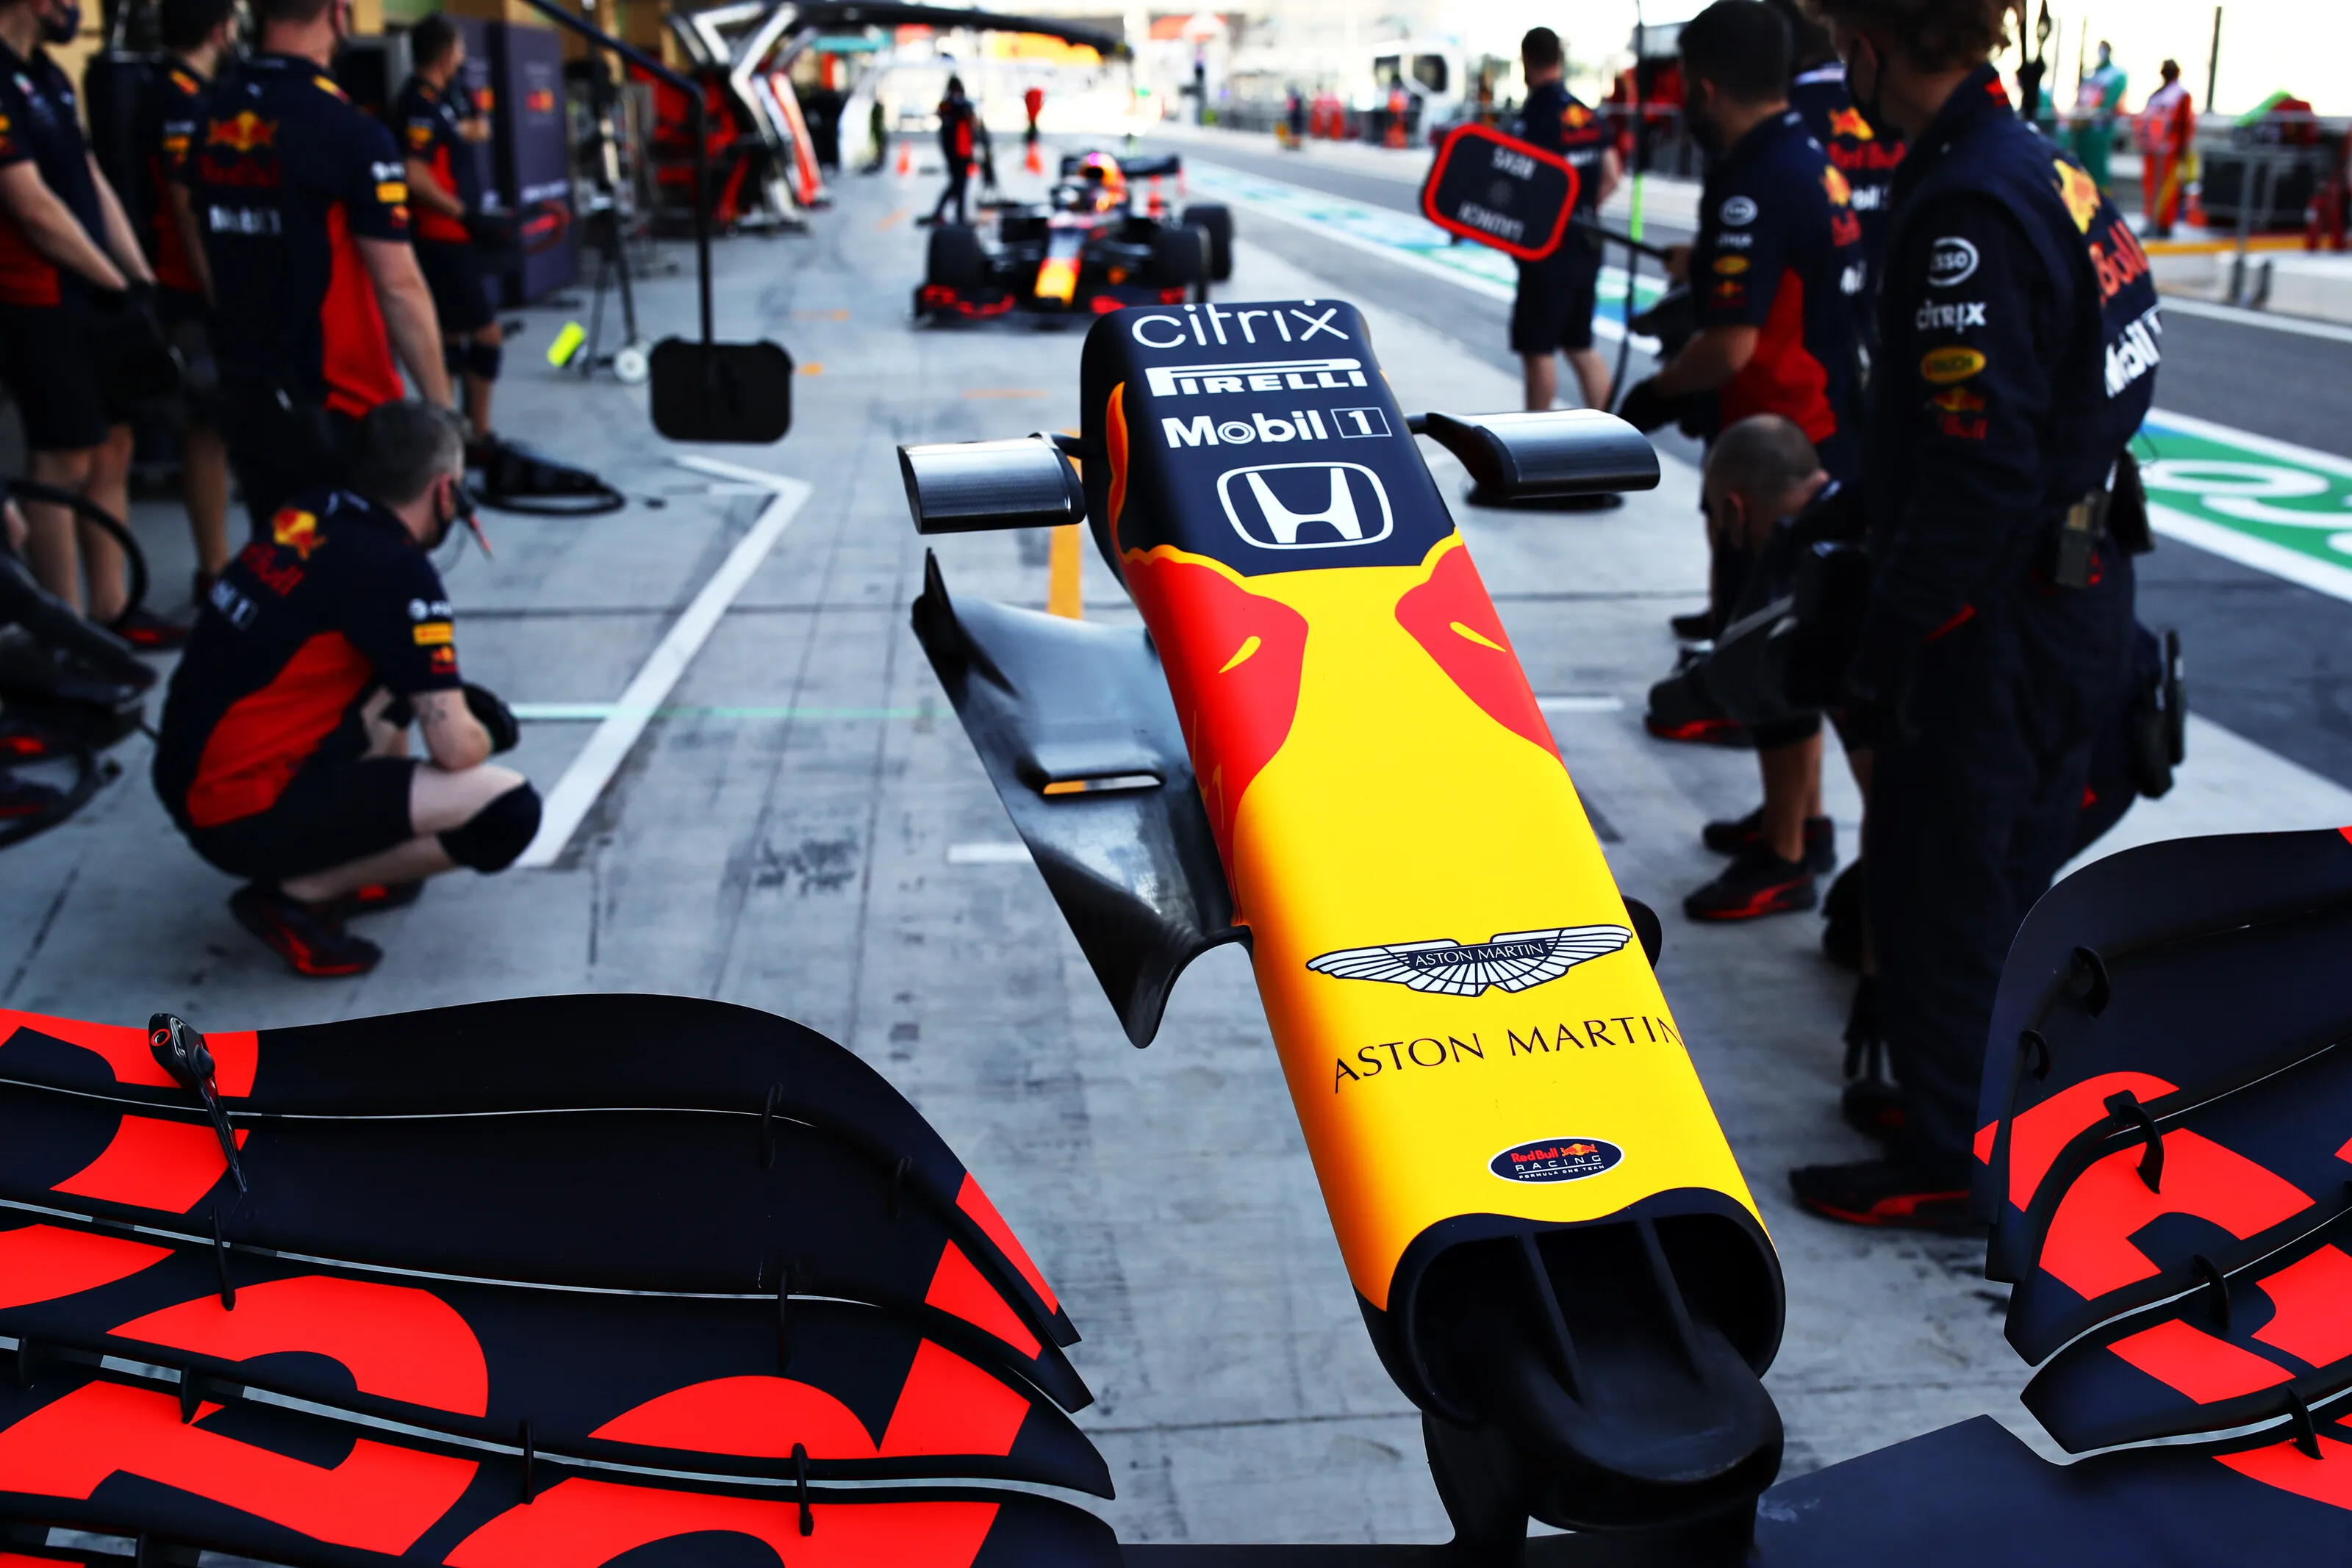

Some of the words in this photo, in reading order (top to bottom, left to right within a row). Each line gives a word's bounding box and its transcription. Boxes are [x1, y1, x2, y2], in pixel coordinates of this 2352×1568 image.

[1132, 299, 1349, 348] citrix
[1145, 358, 1368, 397] PIRELLI
[1161, 409, 1328, 448] Mobil
[1415, 949, 1472, 967] ASTON
[1477, 942, 1544, 962] MARTIN
[1335, 1032, 1485, 1094] ASTON
[1507, 1015, 1685, 1057] MARTIN
[1511, 1151, 1535, 1162] Red
[1535, 1148, 1558, 1159] Bull
[1515, 1154, 1602, 1172] RACING
[1519, 1170, 1559, 1179] FORMULA
